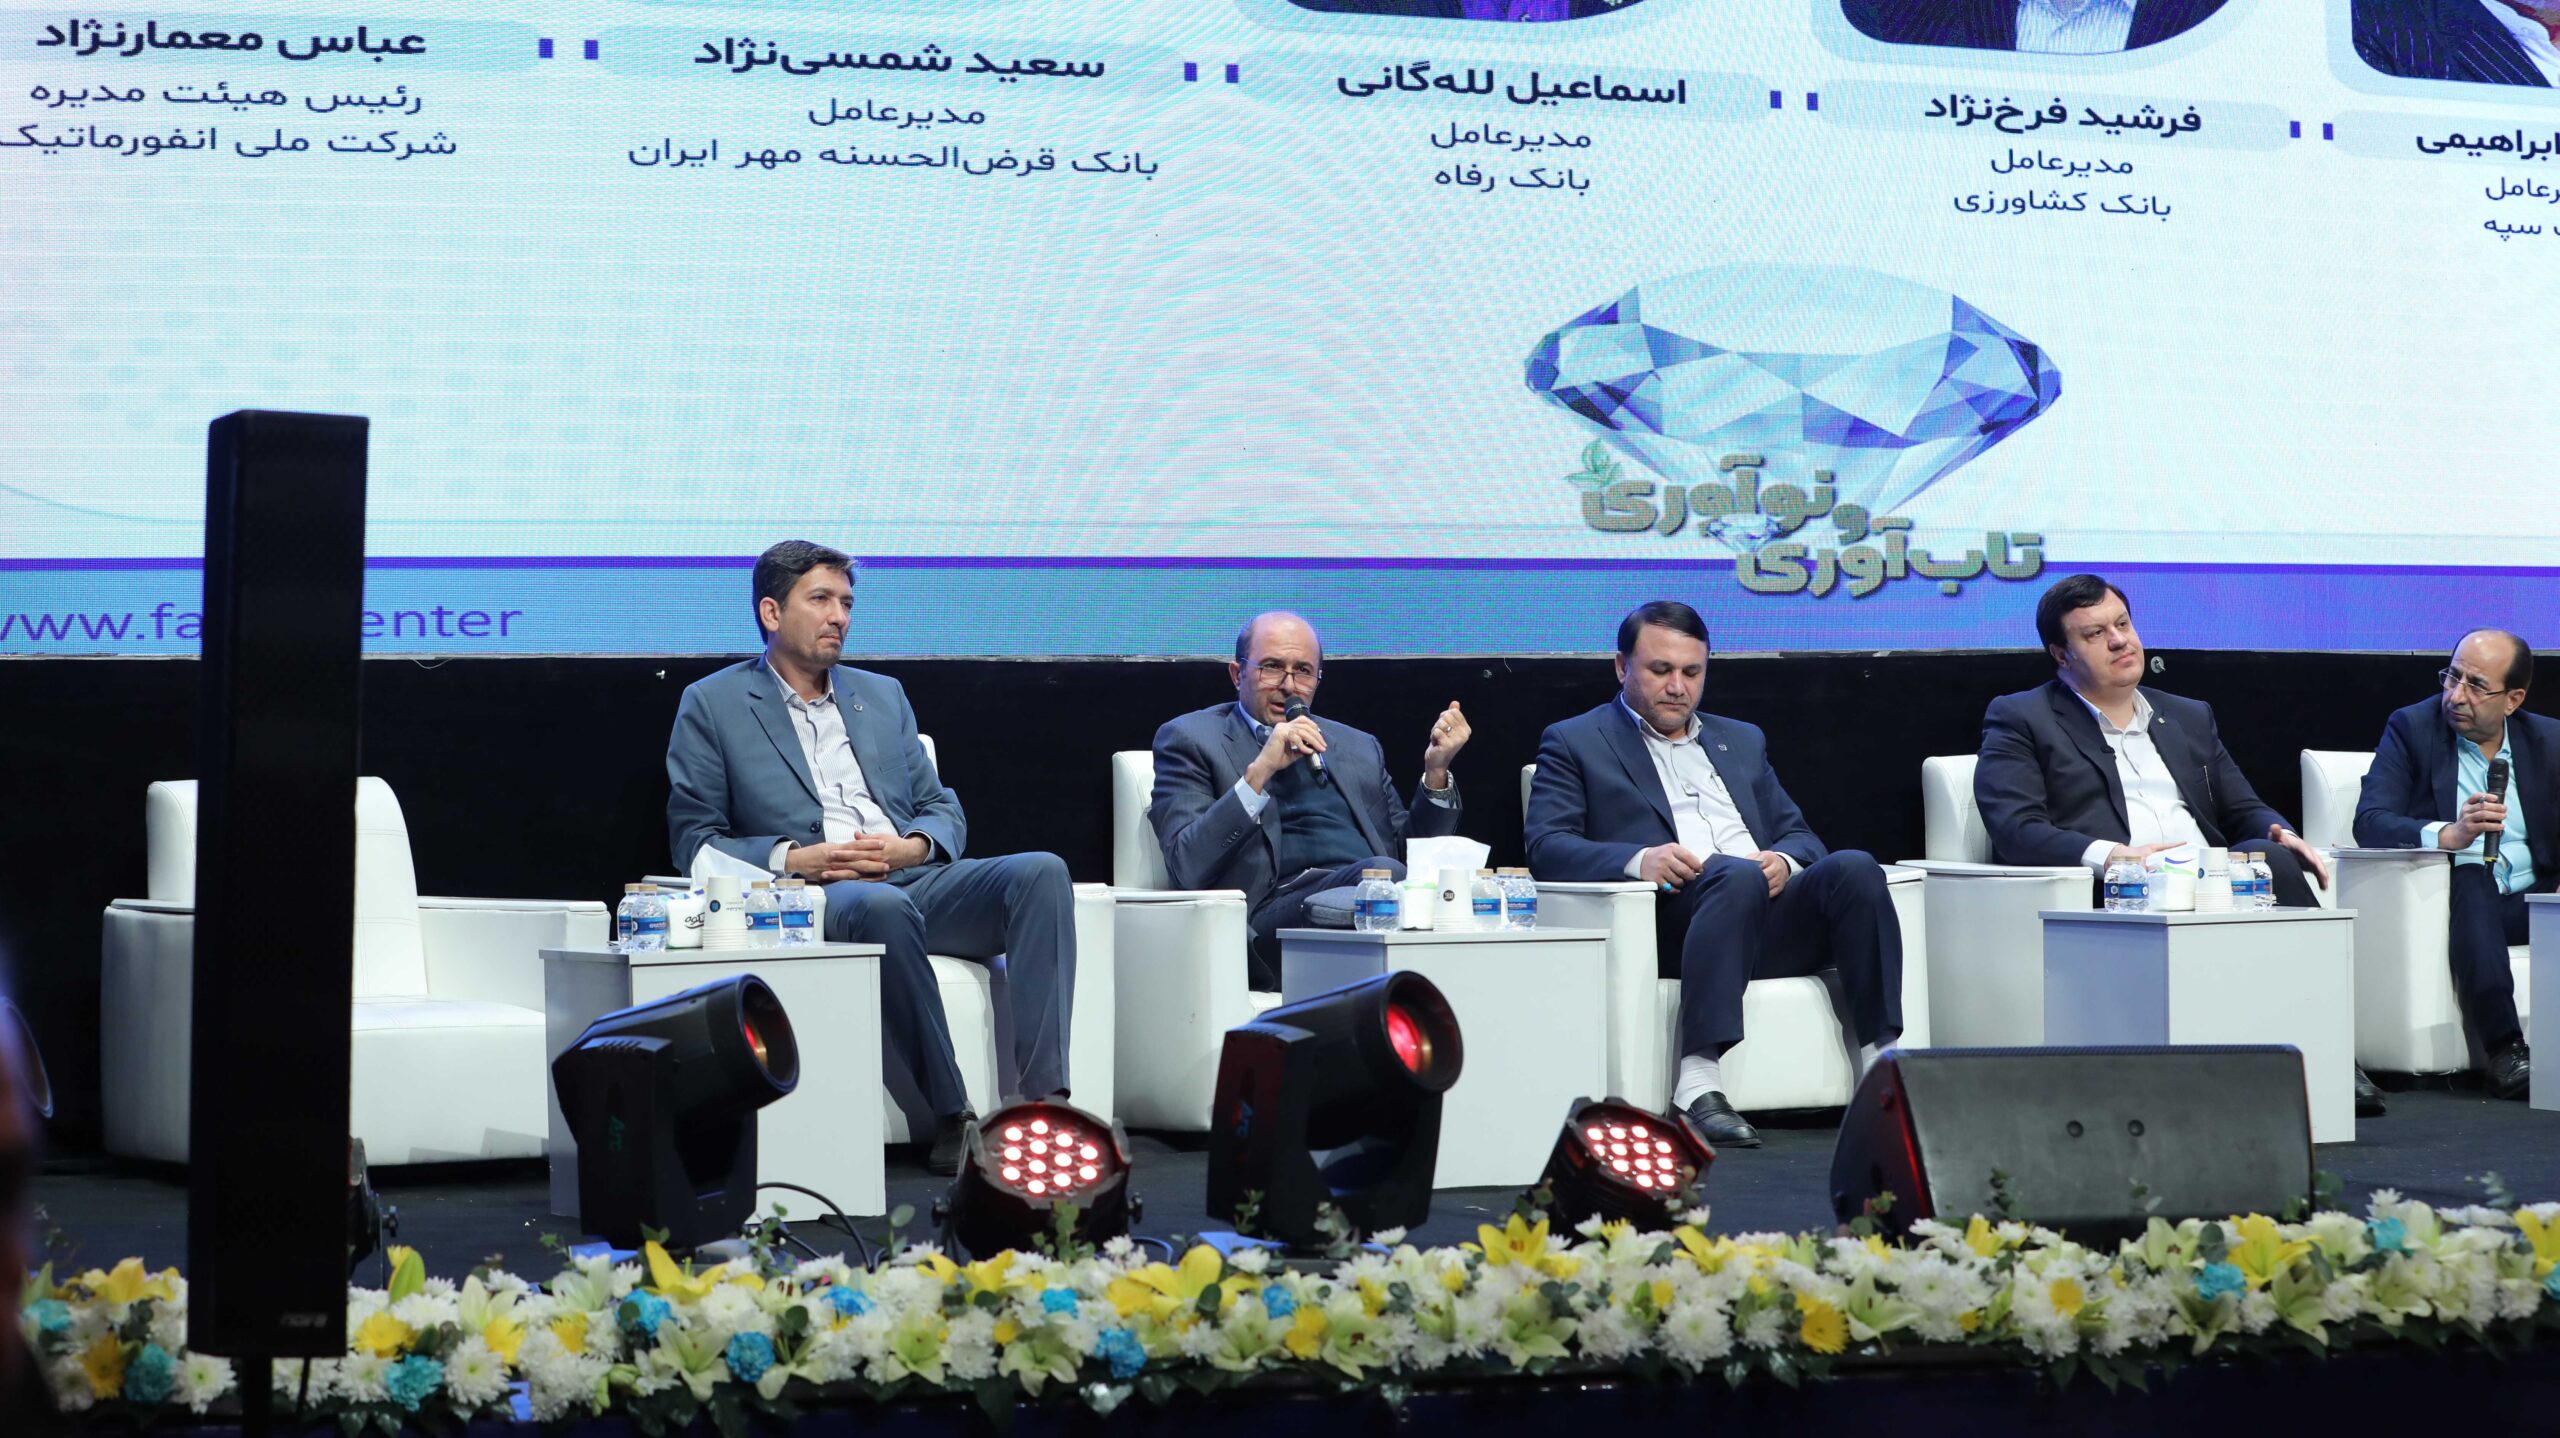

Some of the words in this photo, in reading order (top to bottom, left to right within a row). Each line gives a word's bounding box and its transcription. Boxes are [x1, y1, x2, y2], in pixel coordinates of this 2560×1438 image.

[37, 19, 264, 57] معمارنژاد
[278, 25, 427, 62] عباس
[966, 51, 1105, 83] سعید
[30, 84, 146, 108] مدیره
[162, 81, 288, 112] هیئت
[305, 85, 422, 115] رئیس
[1506, 72, 1686, 106] اسماعیل
[808, 98, 986, 129] مدیرعامل
[2078, 105, 2202, 139] فرشید
[0, 124, 217, 156] انفورماتیک
[235, 128, 310, 158] ملی
[327, 130, 457, 160] شرکت
[1431, 122, 1591, 152] مدیرعامل
[2416, 129, 2560, 161] ابراهیمی
[628, 138, 717, 168] ایران
[735, 145, 802, 169] مهر
[1071, 152, 1159, 180] بانک
[1990, 149, 2133, 177] مدیرعامل
[1434, 164, 1495, 193] رفاه
[1510, 168, 1590, 197] بانک
[2485, 177, 2560, 204] رعامل
[1953, 190, 2087, 215] کشاورزی
[2101, 194, 2171, 222] بانک
[2484, 219, 2542, 242] سپه
[1581, 454, 1837, 538] نوآوری
[1832, 503, 1869, 545] و
